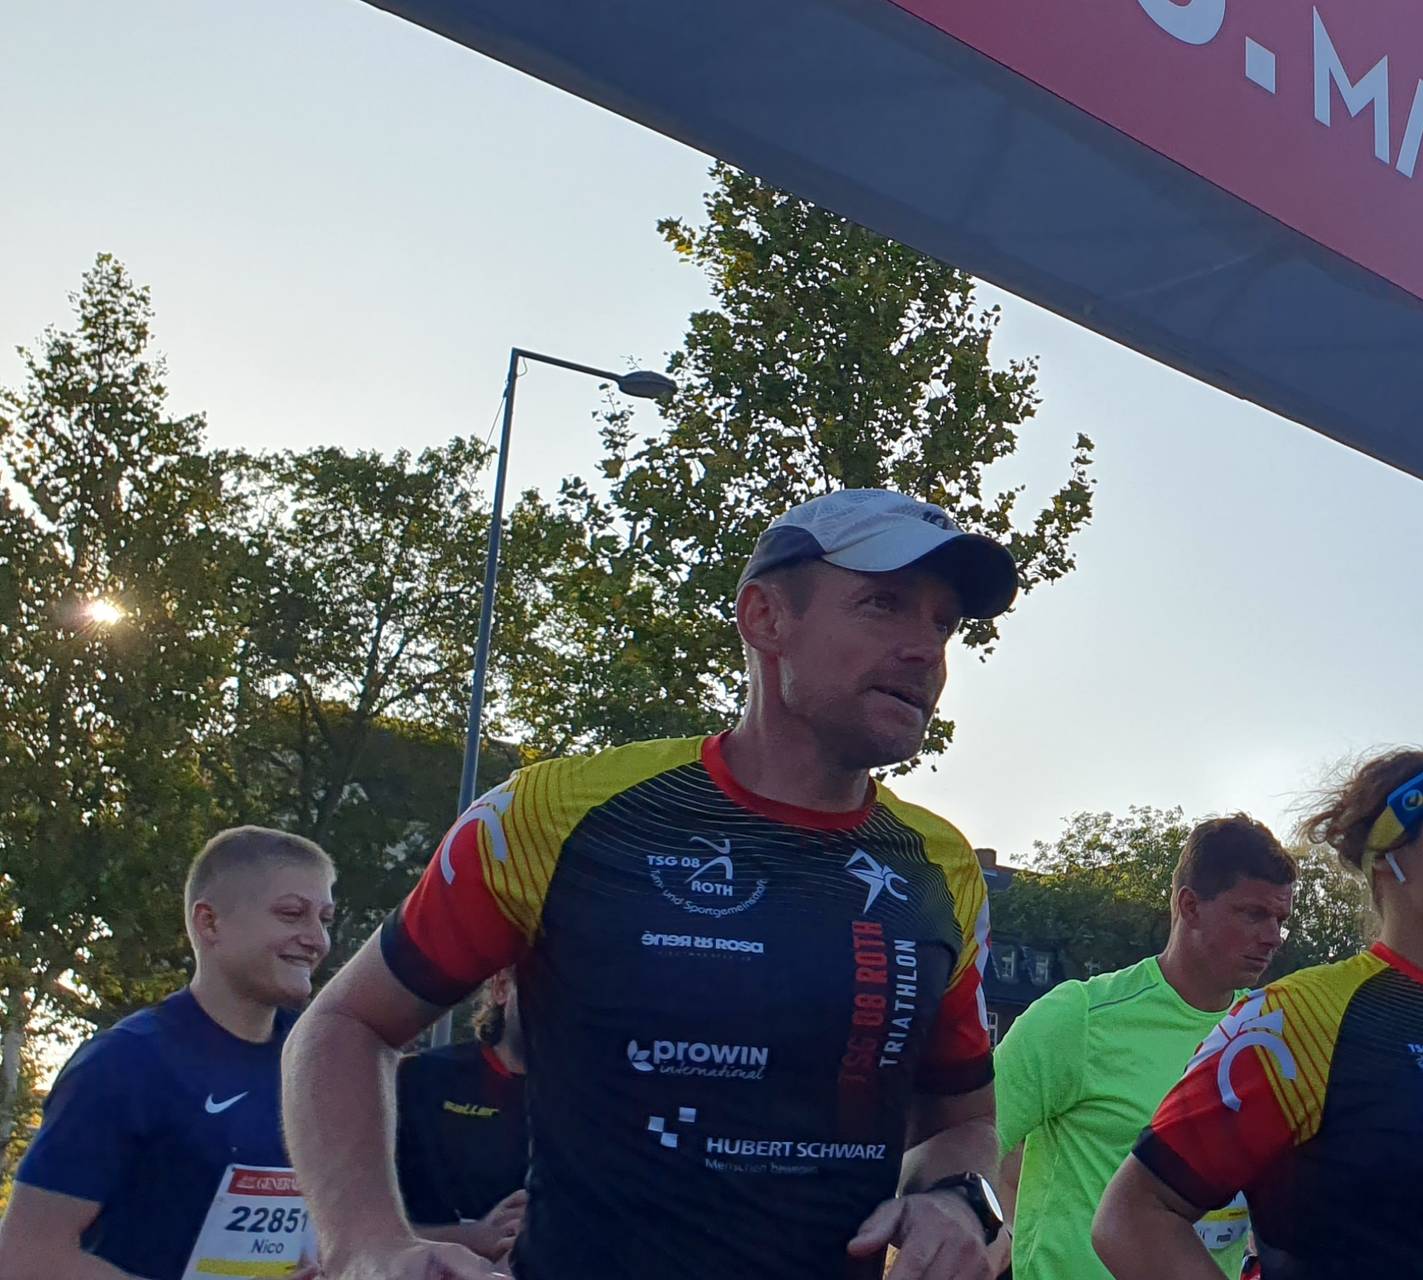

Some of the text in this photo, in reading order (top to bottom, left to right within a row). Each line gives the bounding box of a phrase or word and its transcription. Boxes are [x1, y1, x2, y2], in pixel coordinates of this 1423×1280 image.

[646, 854, 701, 868] TSG 08
[662, 889, 685, 905] und
[691, 880, 734, 897] ROTH
[852, 920, 889, 985] ROTH
[879, 938, 918, 1069] TRIATHLON
[659, 1062, 767, 1081] international
[705, 1137, 886, 1160] HUBERT SCHWARZ
[250, 1238, 285, 1254] Nico
